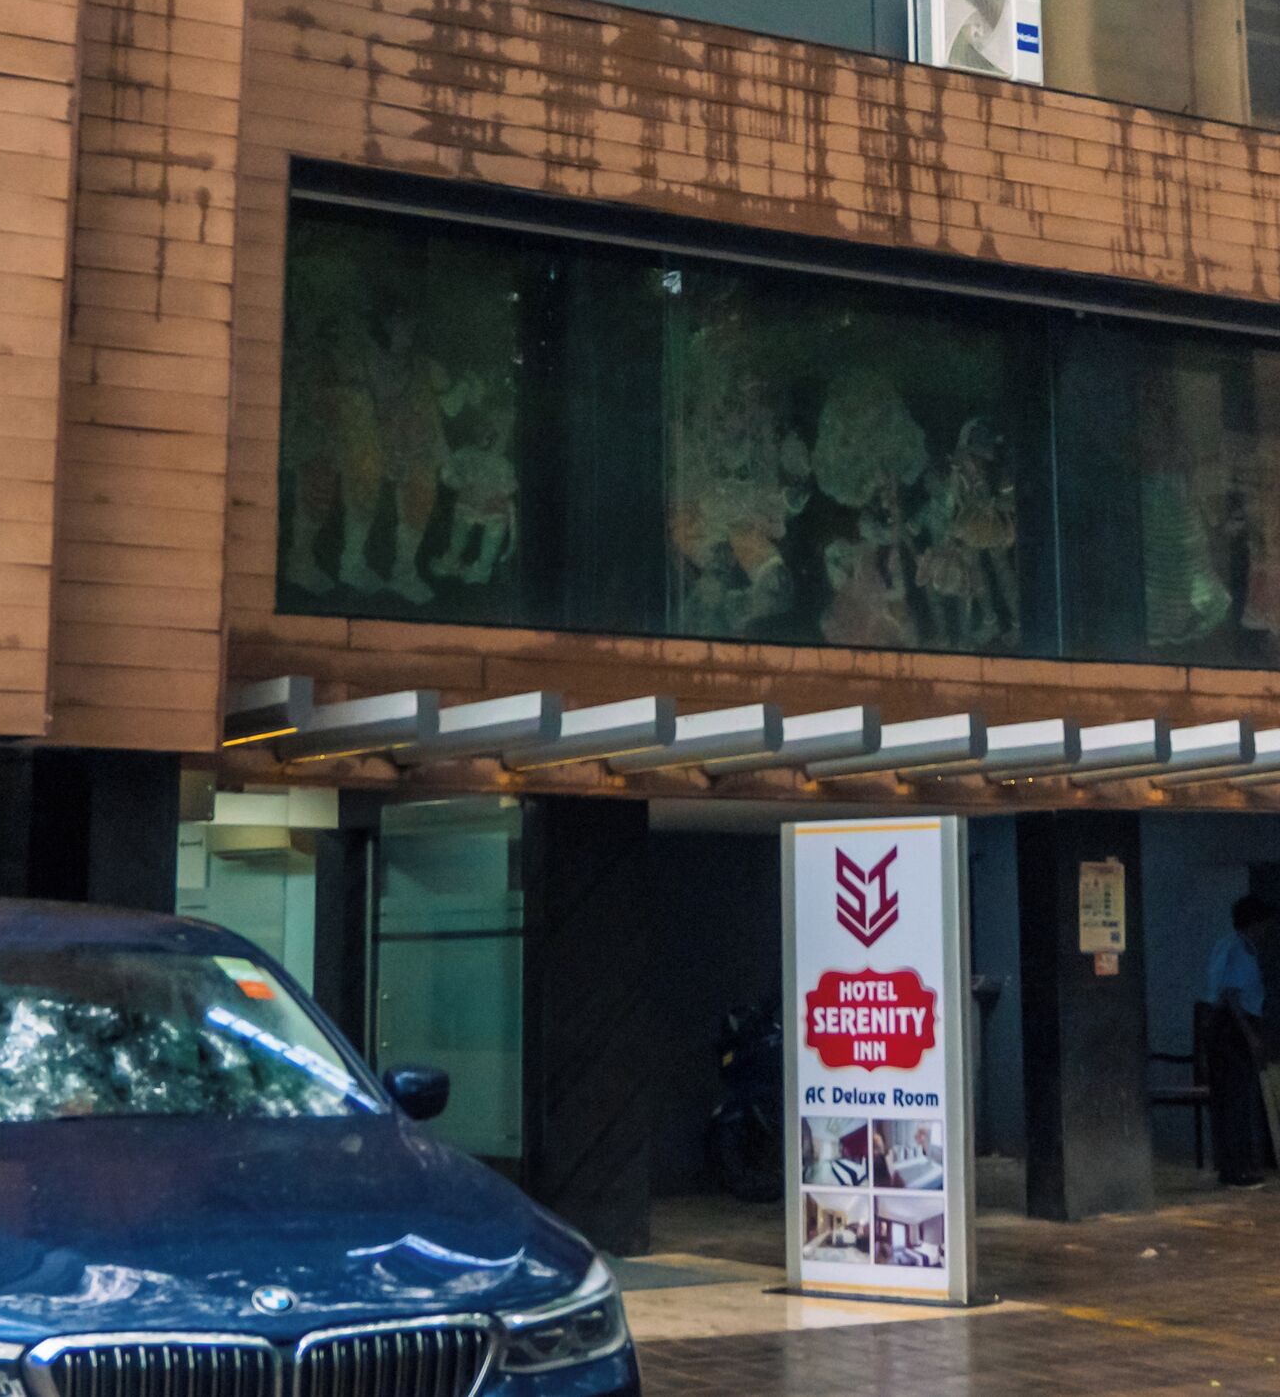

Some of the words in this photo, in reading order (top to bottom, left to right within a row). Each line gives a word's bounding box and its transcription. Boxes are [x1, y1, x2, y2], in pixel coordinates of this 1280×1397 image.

[839, 980, 898, 1003] HOTEL
[813, 1006, 927, 1036] SERENITY
[853, 1040, 886, 1061] INN
[805, 1086, 825, 1105] AC
[832, 1087, 886, 1106] Deluxe
[893, 1088, 939, 1108] Room
